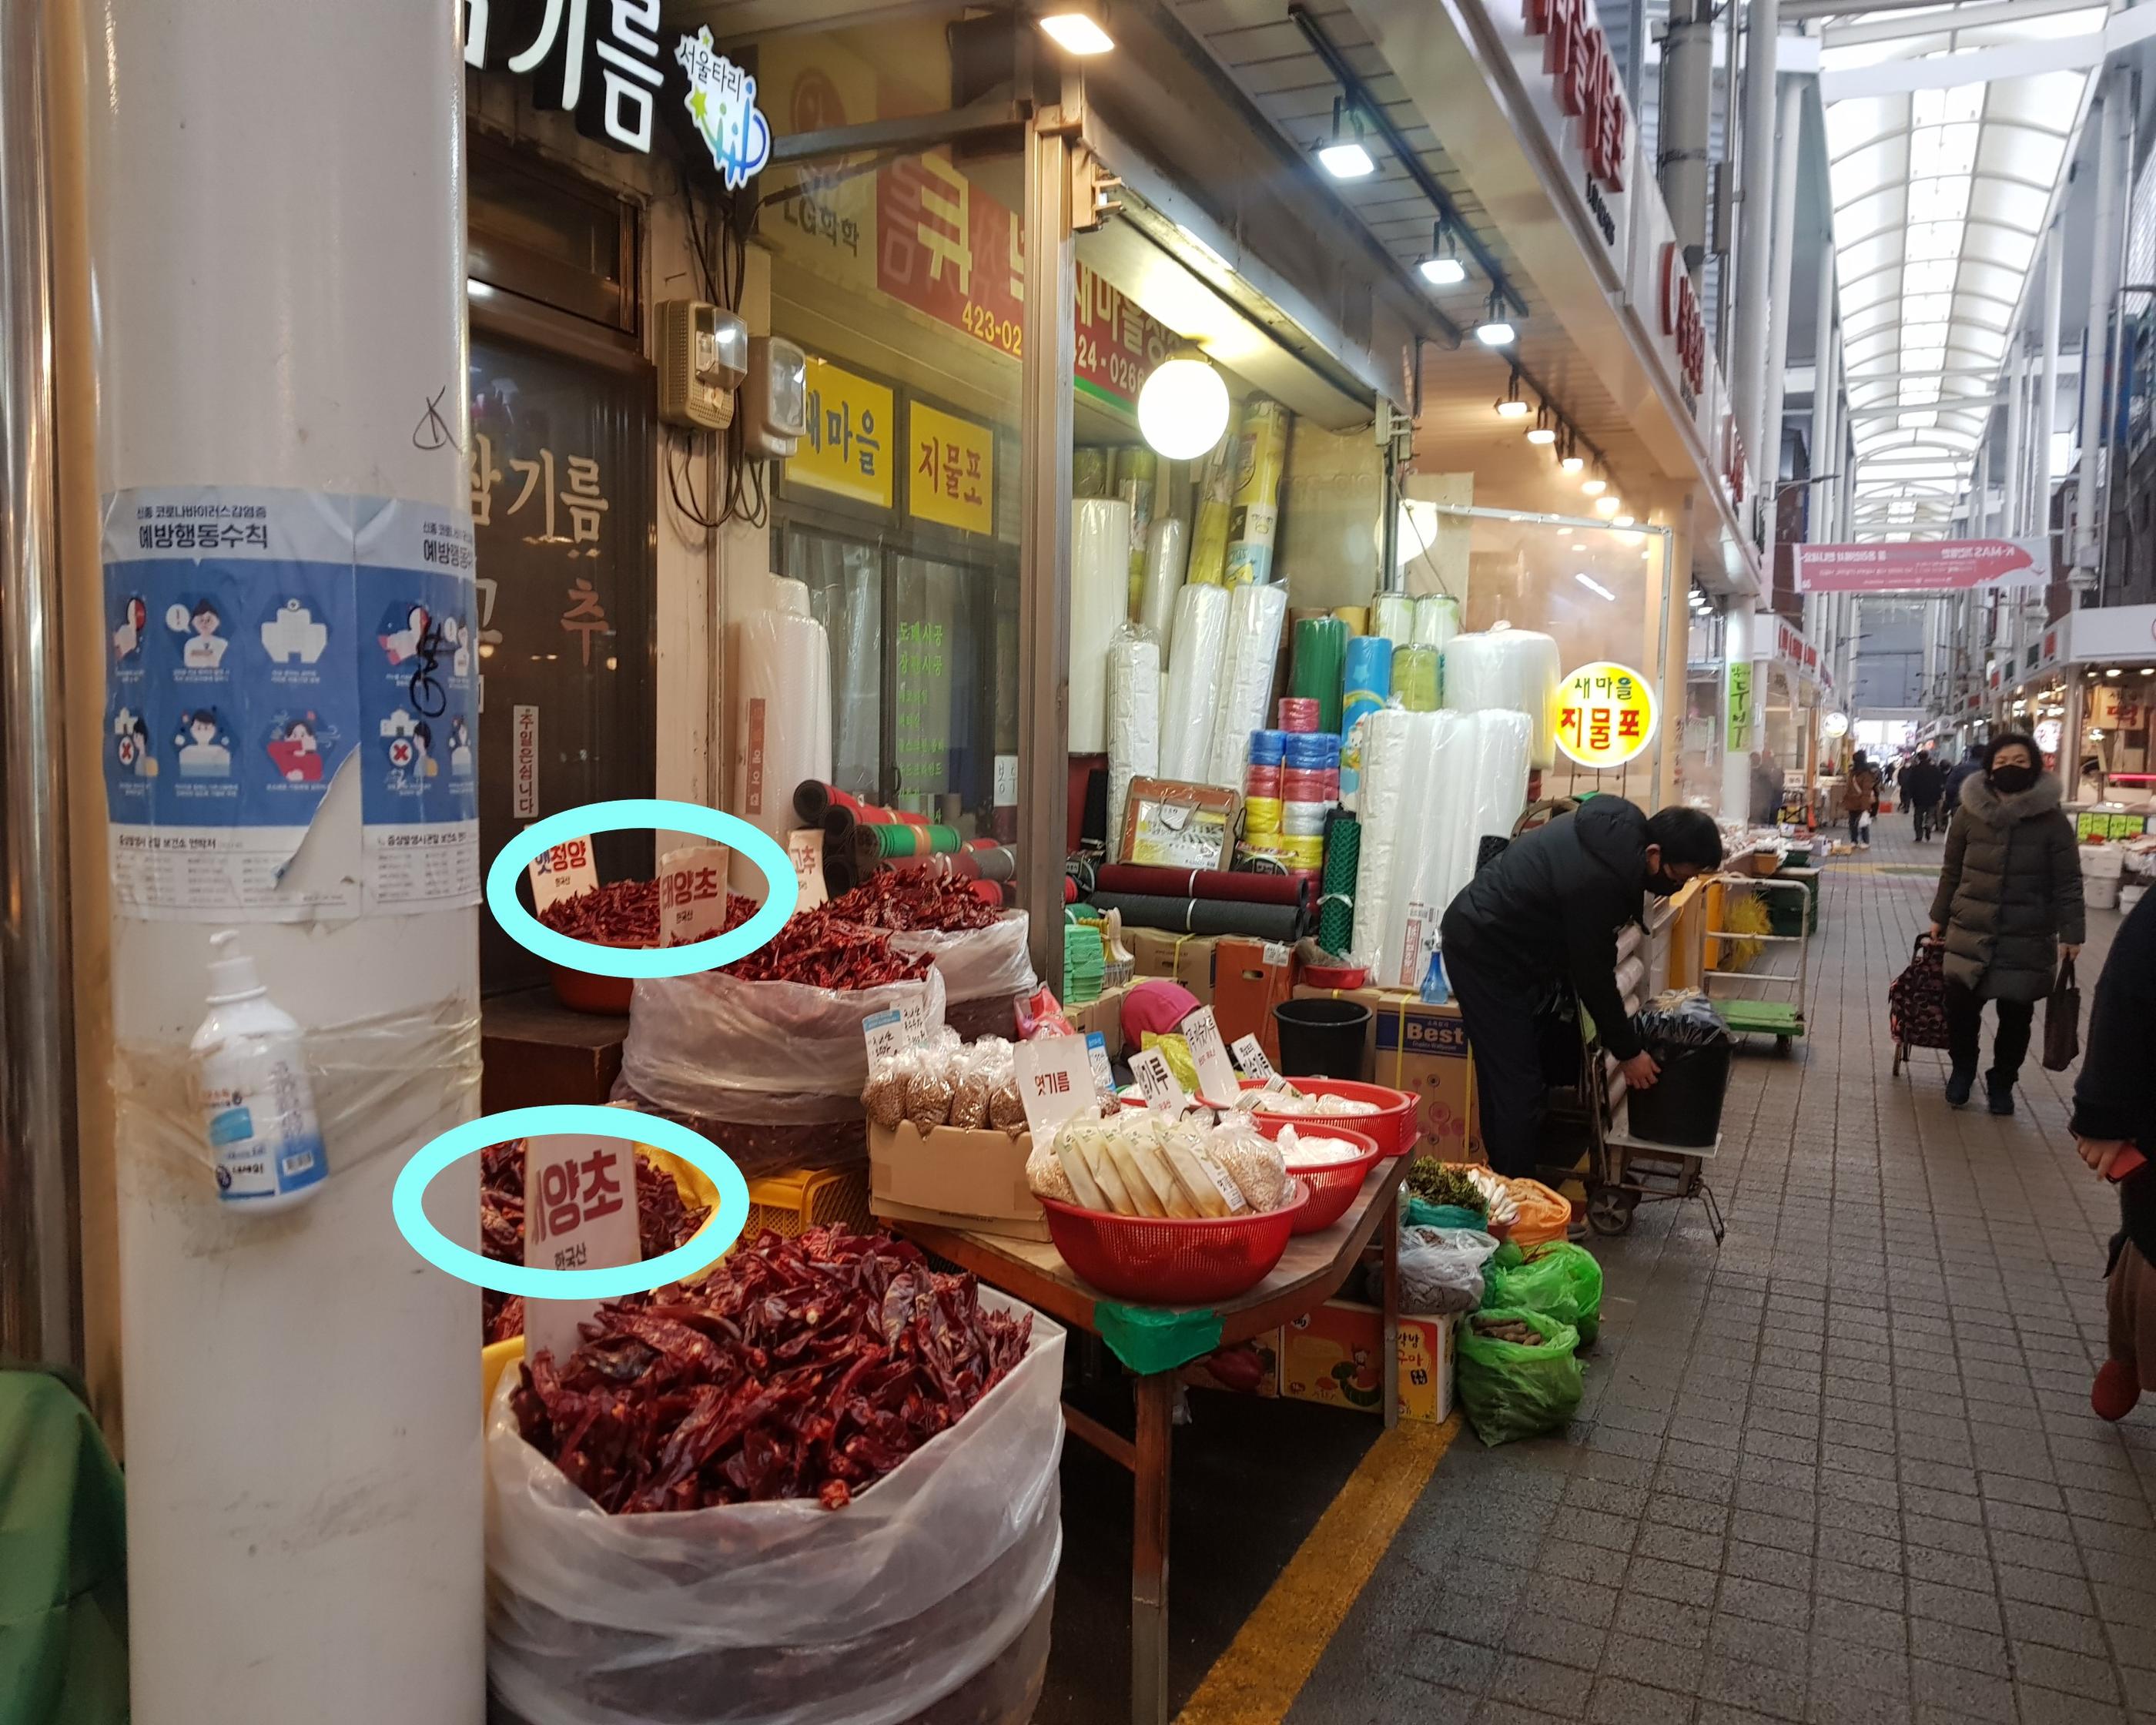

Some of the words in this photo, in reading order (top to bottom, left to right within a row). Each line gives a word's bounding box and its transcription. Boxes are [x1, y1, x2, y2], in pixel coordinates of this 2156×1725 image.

[464, 0, 664, 153] 기름
[681, 42, 742, 103] 서울타리
[1073, 332, 1146, 394] 24-0266
[919, 437, 983, 506] 지물포
[139, 523, 268, 549] 예방행동수칙
[1575, 676, 1632, 701] 새마을
[1560, 707, 1640, 750] 지물포
[661, 866, 718, 910] 태양초
[1407, 1022, 1464, 1045] Best
[1033, 1070, 1070, 1096] 엿기름
[554, 1242, 587, 1271] 한국산
